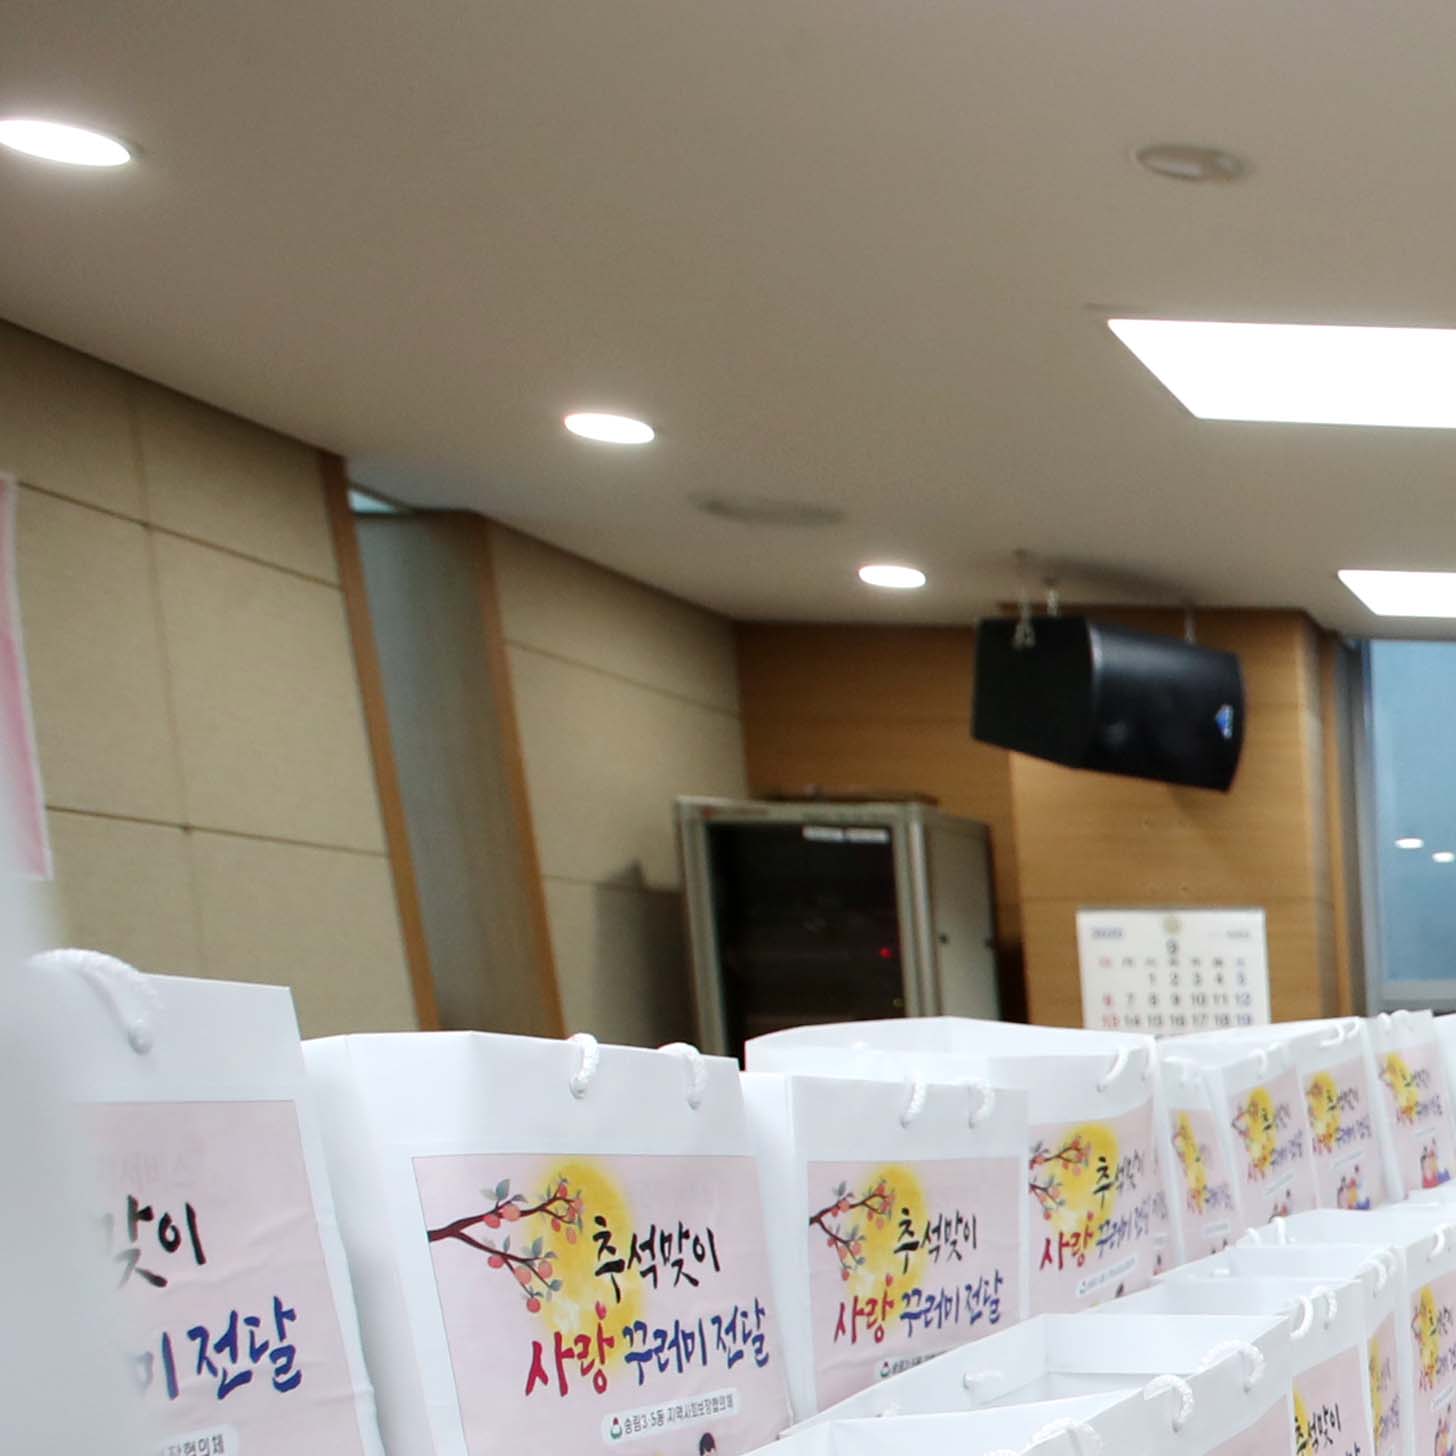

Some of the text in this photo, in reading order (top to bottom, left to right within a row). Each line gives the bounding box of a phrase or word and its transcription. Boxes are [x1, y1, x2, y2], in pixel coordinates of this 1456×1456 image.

[592, 1215, 720, 1304] 추석맞이
[892, 1207, 978, 1275] 추석맞이
[186, 1296, 302, 1400] 전달
[525, 1297, 769, 1397] 사랑 꾸러미 전달
[833, 1269, 1003, 1345] 사랑 꾸러미 전달
